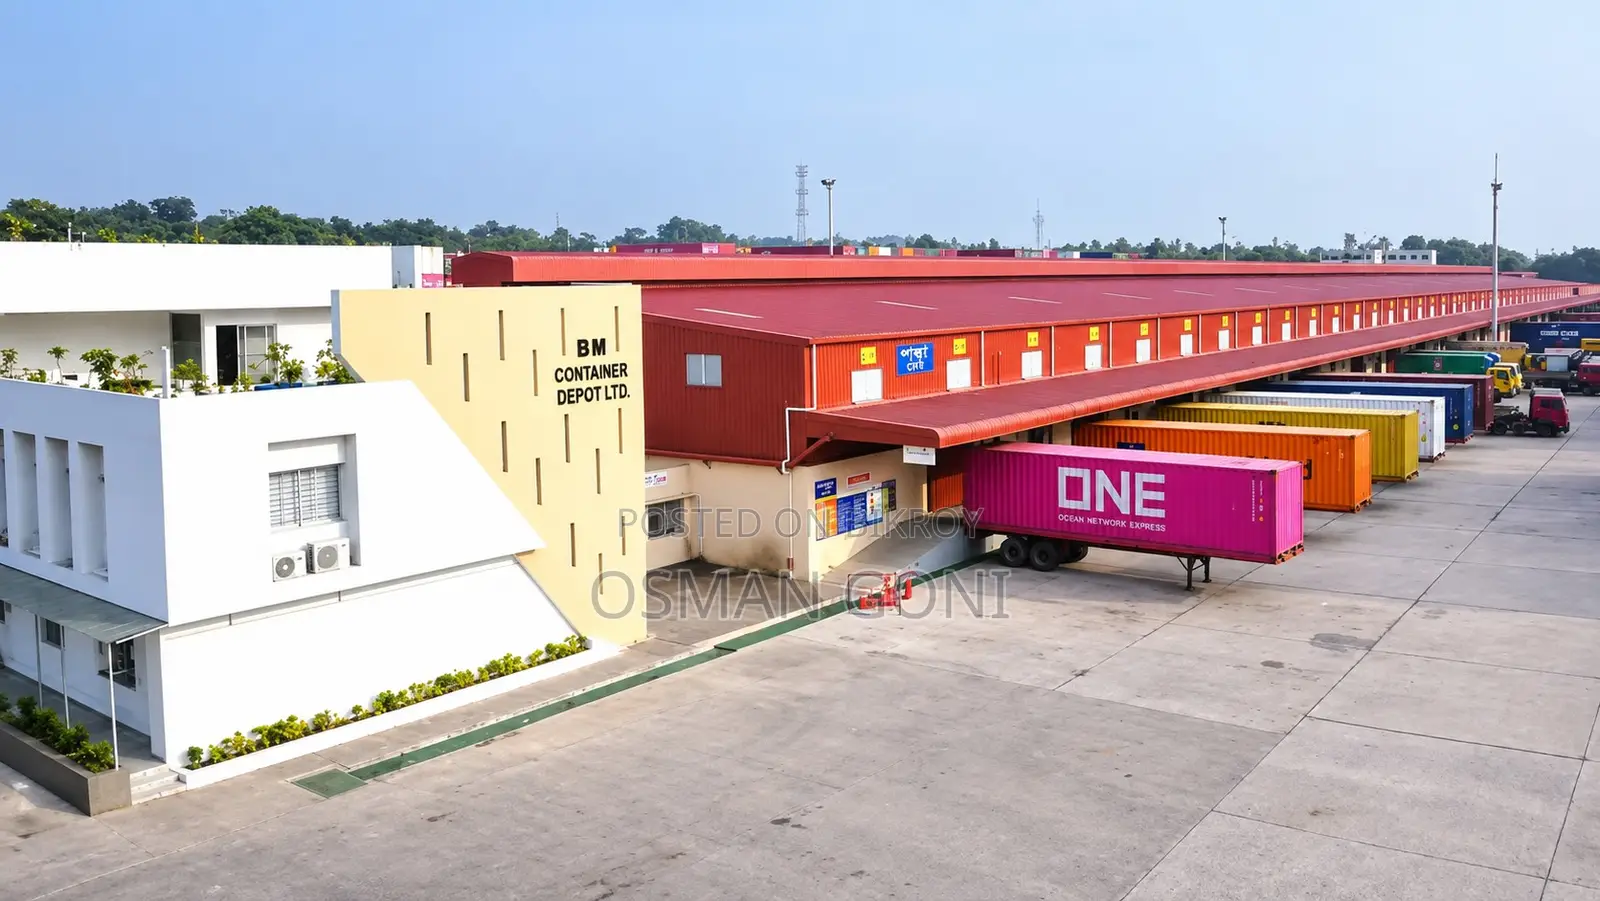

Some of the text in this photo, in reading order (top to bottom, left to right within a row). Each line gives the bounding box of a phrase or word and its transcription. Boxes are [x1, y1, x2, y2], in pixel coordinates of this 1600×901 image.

[577, 338, 606, 357] BM
[554, 362, 628, 383] CONTAINER
[557, 383, 630, 406] DEPOT LTD.
[1058, 466, 1166, 518] ONE
[1058, 513, 1166, 532] OCEAN NETWORK EXPRESS
